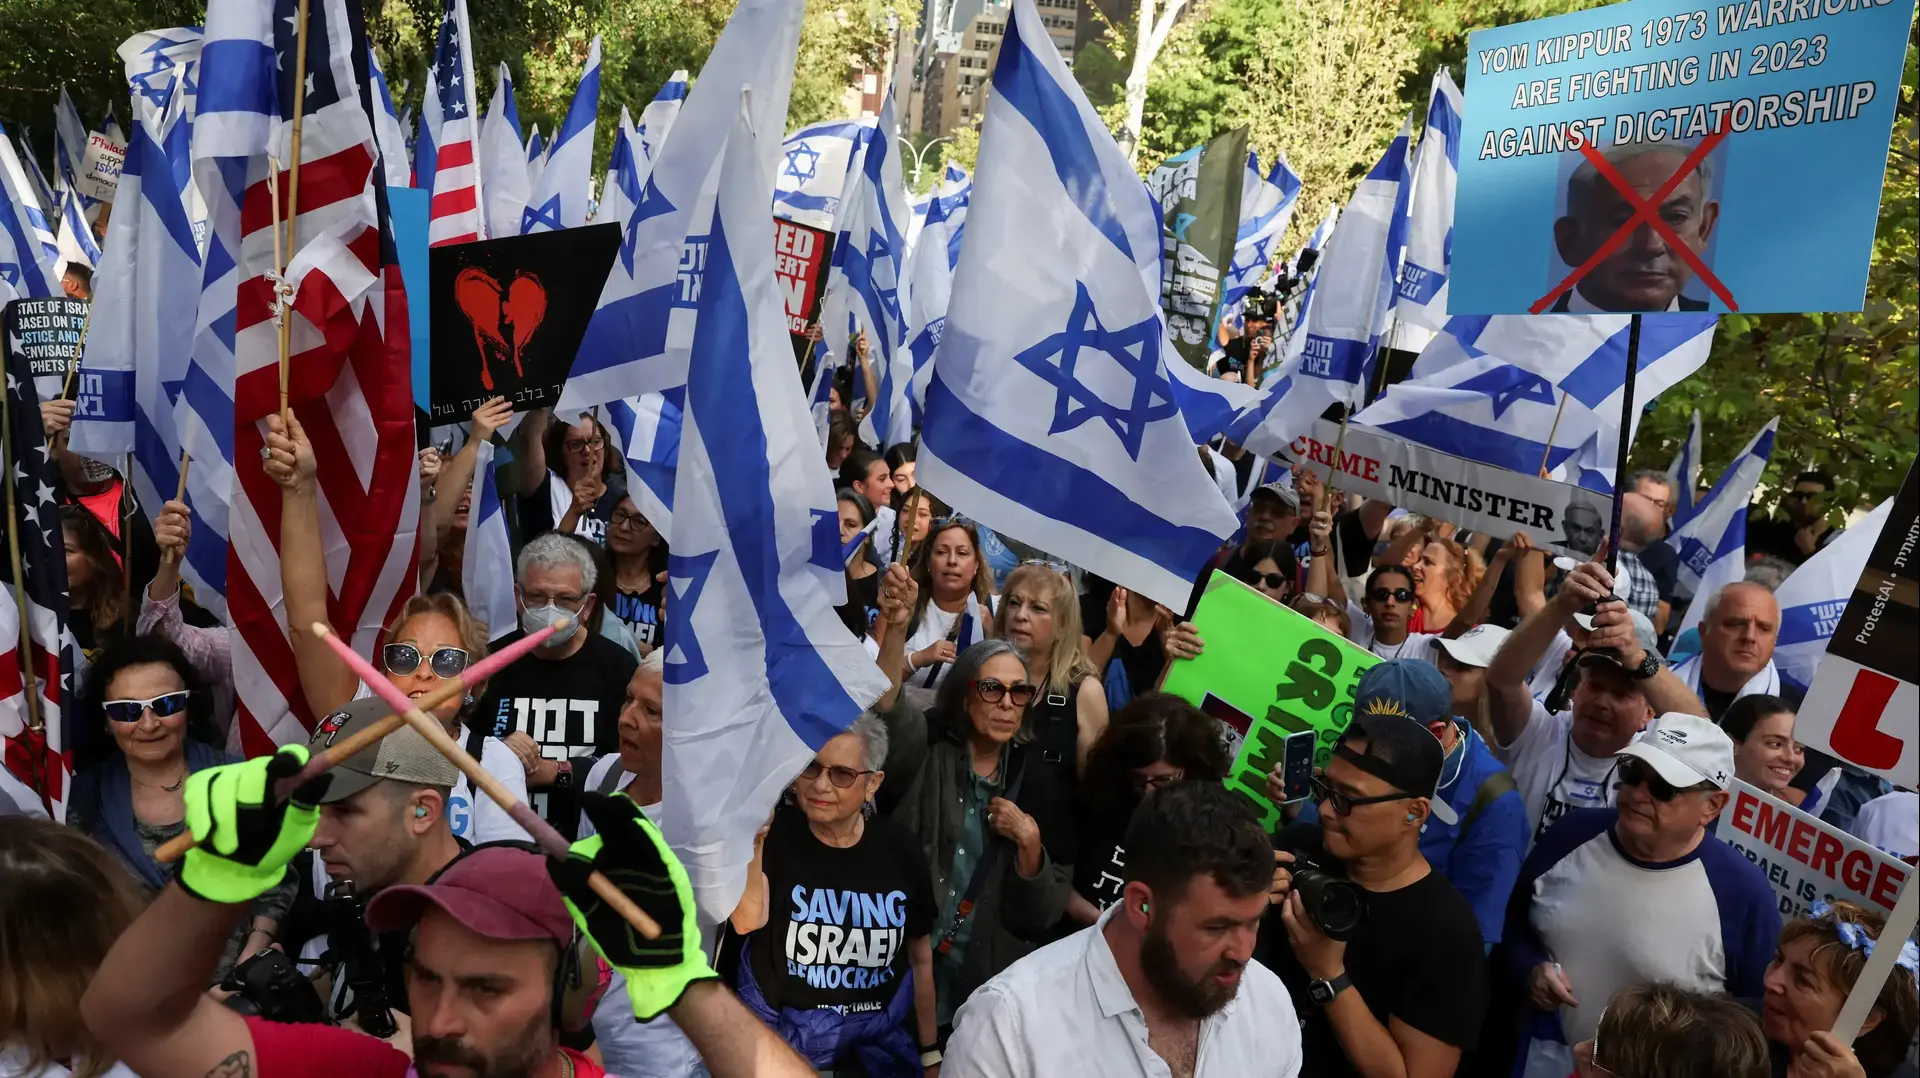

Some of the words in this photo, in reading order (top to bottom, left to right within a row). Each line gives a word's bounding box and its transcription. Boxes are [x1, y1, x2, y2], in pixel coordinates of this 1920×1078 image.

[1479, 43, 1528, 75] YOM
[1535, 24, 1632, 66] KIPPUR
[1642, 10, 1707, 48] 1973
[1511, 77, 1561, 109] ARE
[1568, 56, 1700, 102] FIGHTING
[1708, 49, 1741, 82] IN
[1749, 34, 1828, 75] 2023
[1478, 117, 1606, 160] AGAINST
[1613, 81, 1876, 146] DICTATORSHIP
[48, 301, 61, 313] OF
[65, 301, 91, 316] ISRA
[53, 315, 68, 328] ON
[22, 330, 54, 344] STICE
[58, 330, 79, 344] AND
[31, 359, 65, 373] PHETS
[515, 386, 545, 403] בלב
[1290, 435, 1380, 483] CRIME
[1388, 465, 1555, 531] MINISTER
[1731, 790, 1907, 911] EMERGE
[791, 884, 907, 928] SAVING
[1796, 877, 1817, 902] IS
[785, 920, 904, 967] ISRAEL
